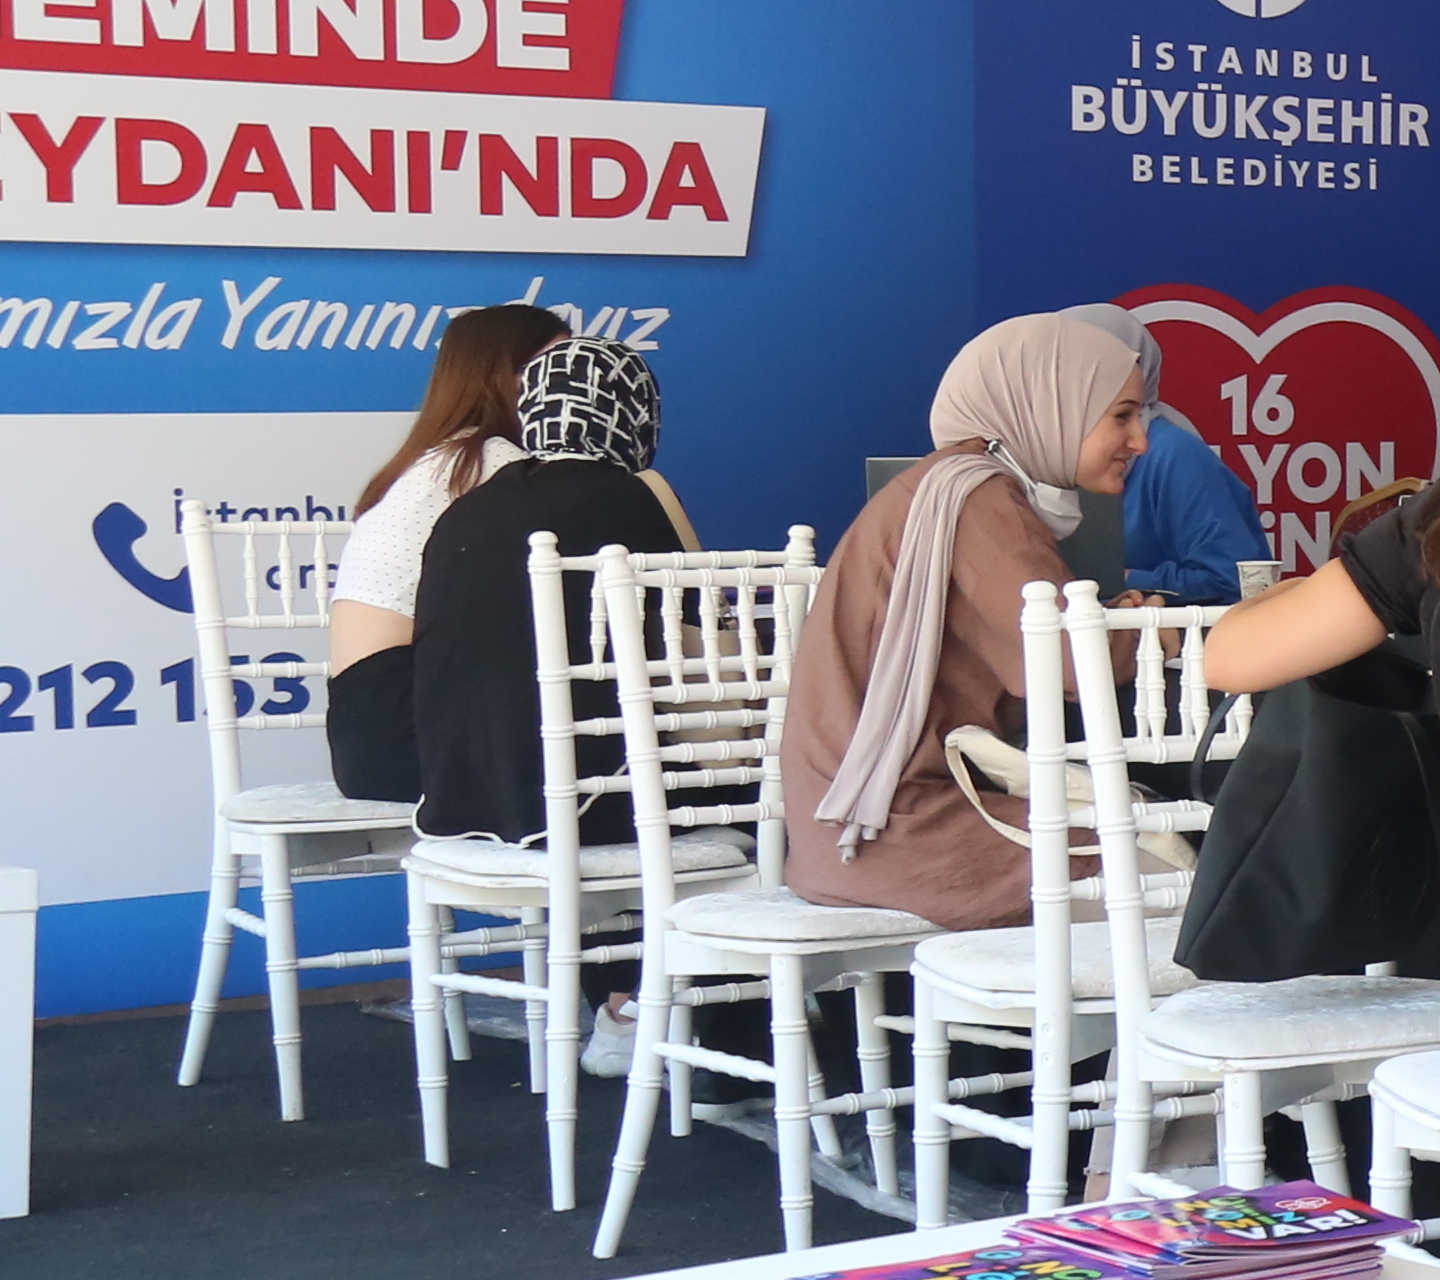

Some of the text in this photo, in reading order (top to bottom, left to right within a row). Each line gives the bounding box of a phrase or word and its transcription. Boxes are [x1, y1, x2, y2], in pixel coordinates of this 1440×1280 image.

[1130, 33, 1380, 84] İSTANBUL
[1069, 76, 1431, 148] BÜYÜKŞEHİR
[0, 111, 730, 223] YDANI'NDA
[1131, 152, 1380, 191] BELEDİYESİ
[1219, 373, 1296, 438] 16
[1208, 441, 1396, 506] YON
[1225, 1209, 1369, 1241] VAR!
